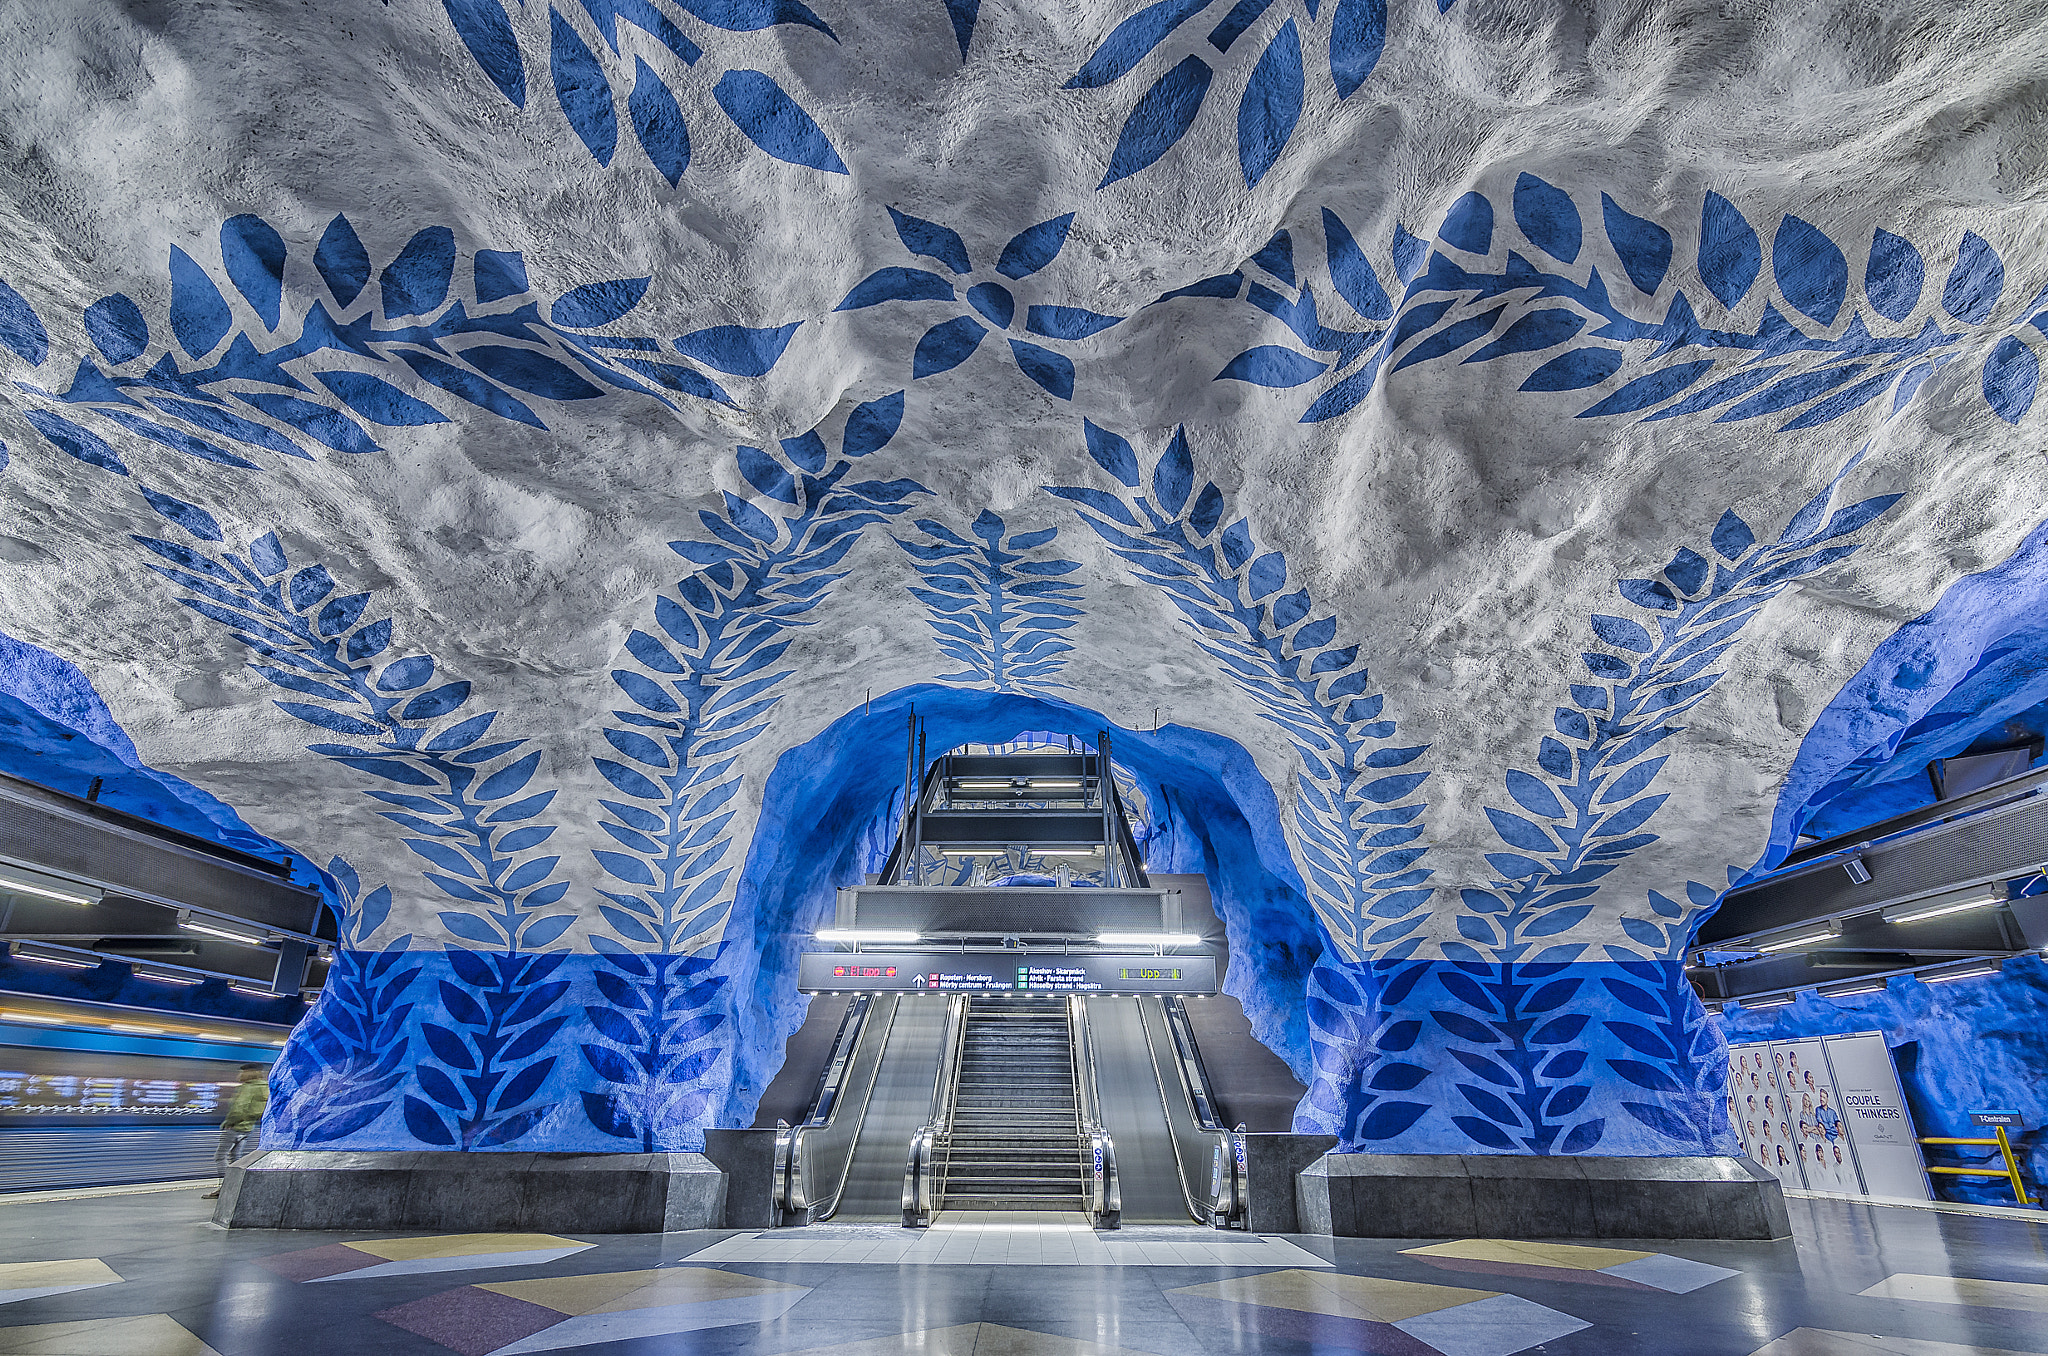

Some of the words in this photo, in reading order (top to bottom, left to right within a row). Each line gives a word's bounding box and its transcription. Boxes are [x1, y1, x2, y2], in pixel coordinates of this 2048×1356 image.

[1140, 968, 1160, 979] Upp
[1846, 1095, 1881, 1105] COUPLE
[1855, 1108, 1900, 1119] THINKERS
[1978, 1115, 2012, 1123] T-Centralen
